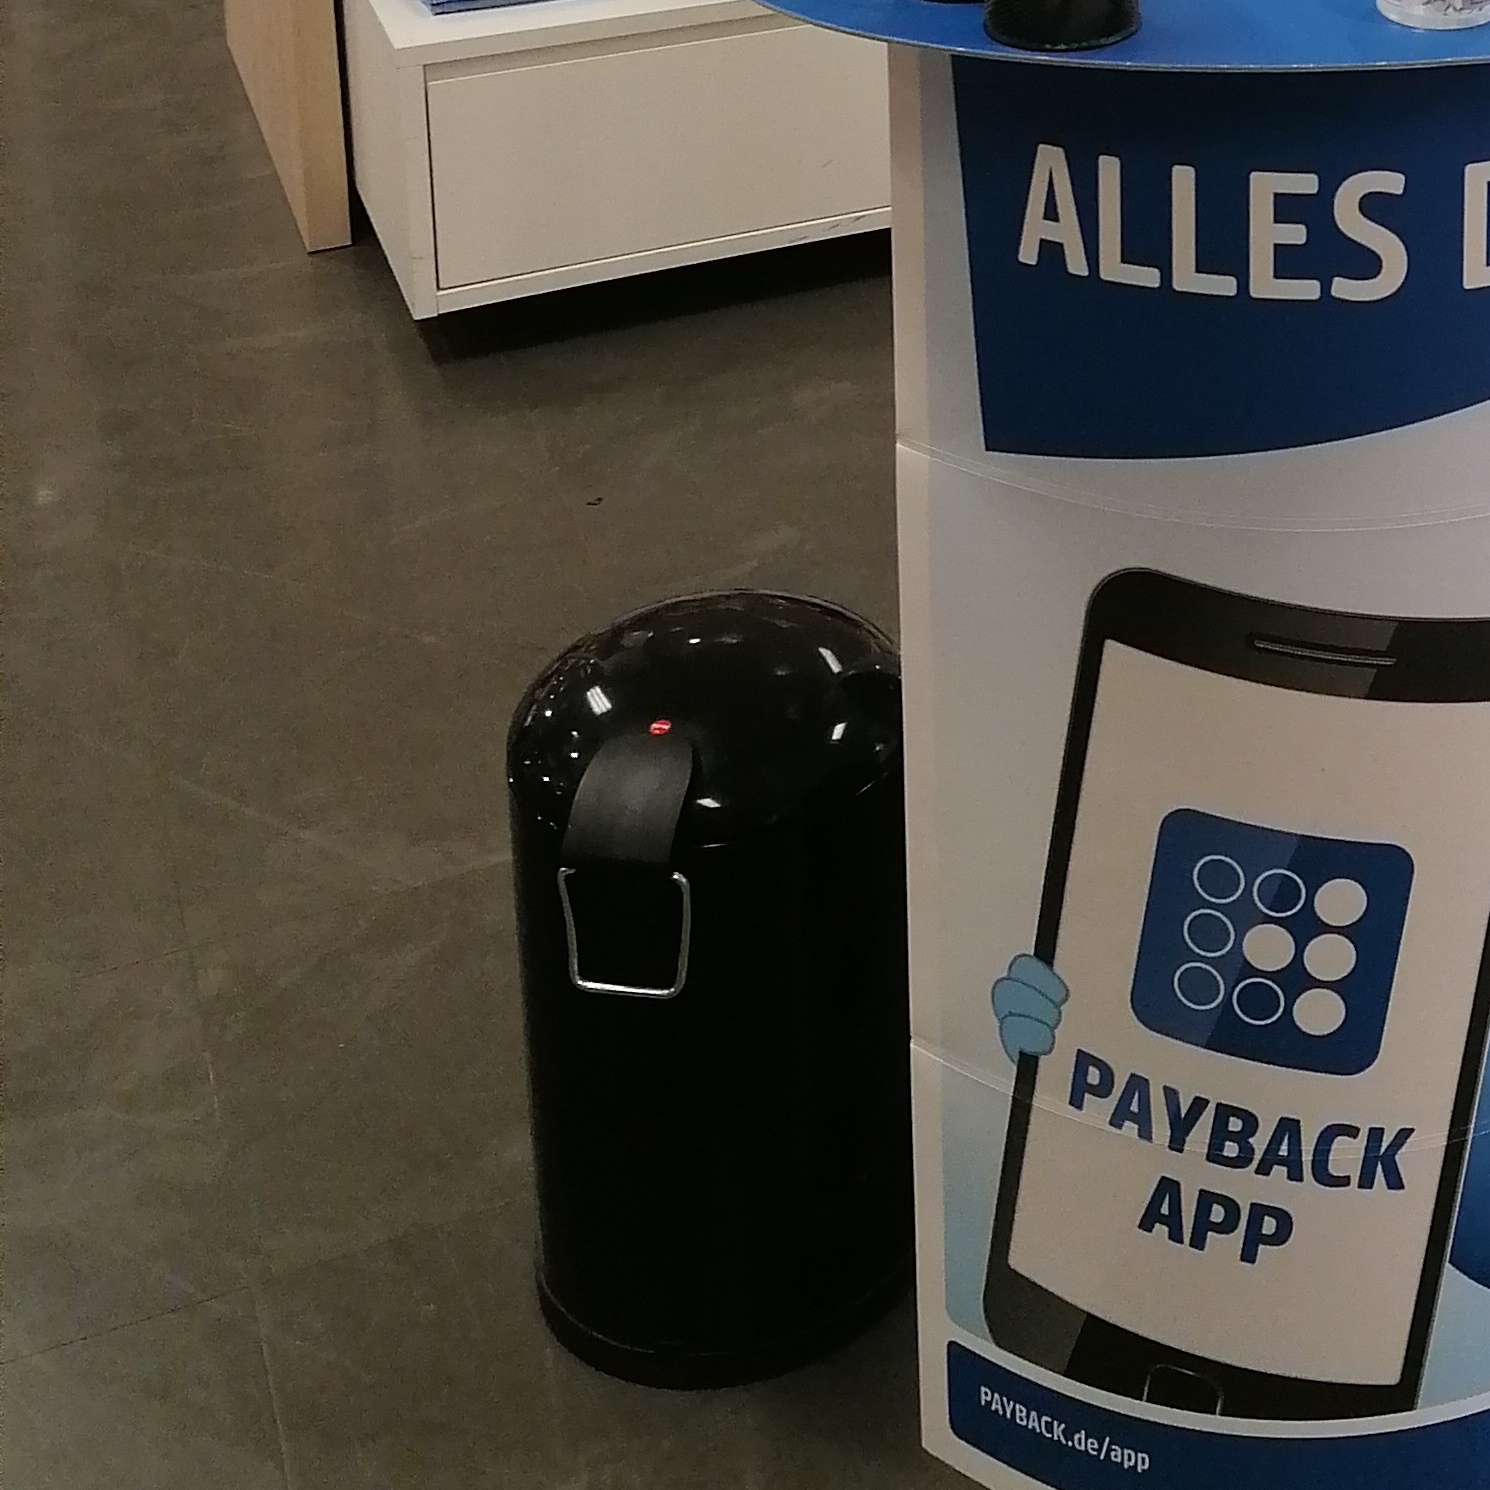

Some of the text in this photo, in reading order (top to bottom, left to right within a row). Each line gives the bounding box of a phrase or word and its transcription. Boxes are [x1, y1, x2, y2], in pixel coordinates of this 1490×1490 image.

[1017, 142, 1409, 302] ALLES
[1067, 1048, 1417, 1192] PAYBACK
[1137, 1175, 1295, 1267] APP
[979, 1383, 1152, 1475] PAYBACK.de/app
